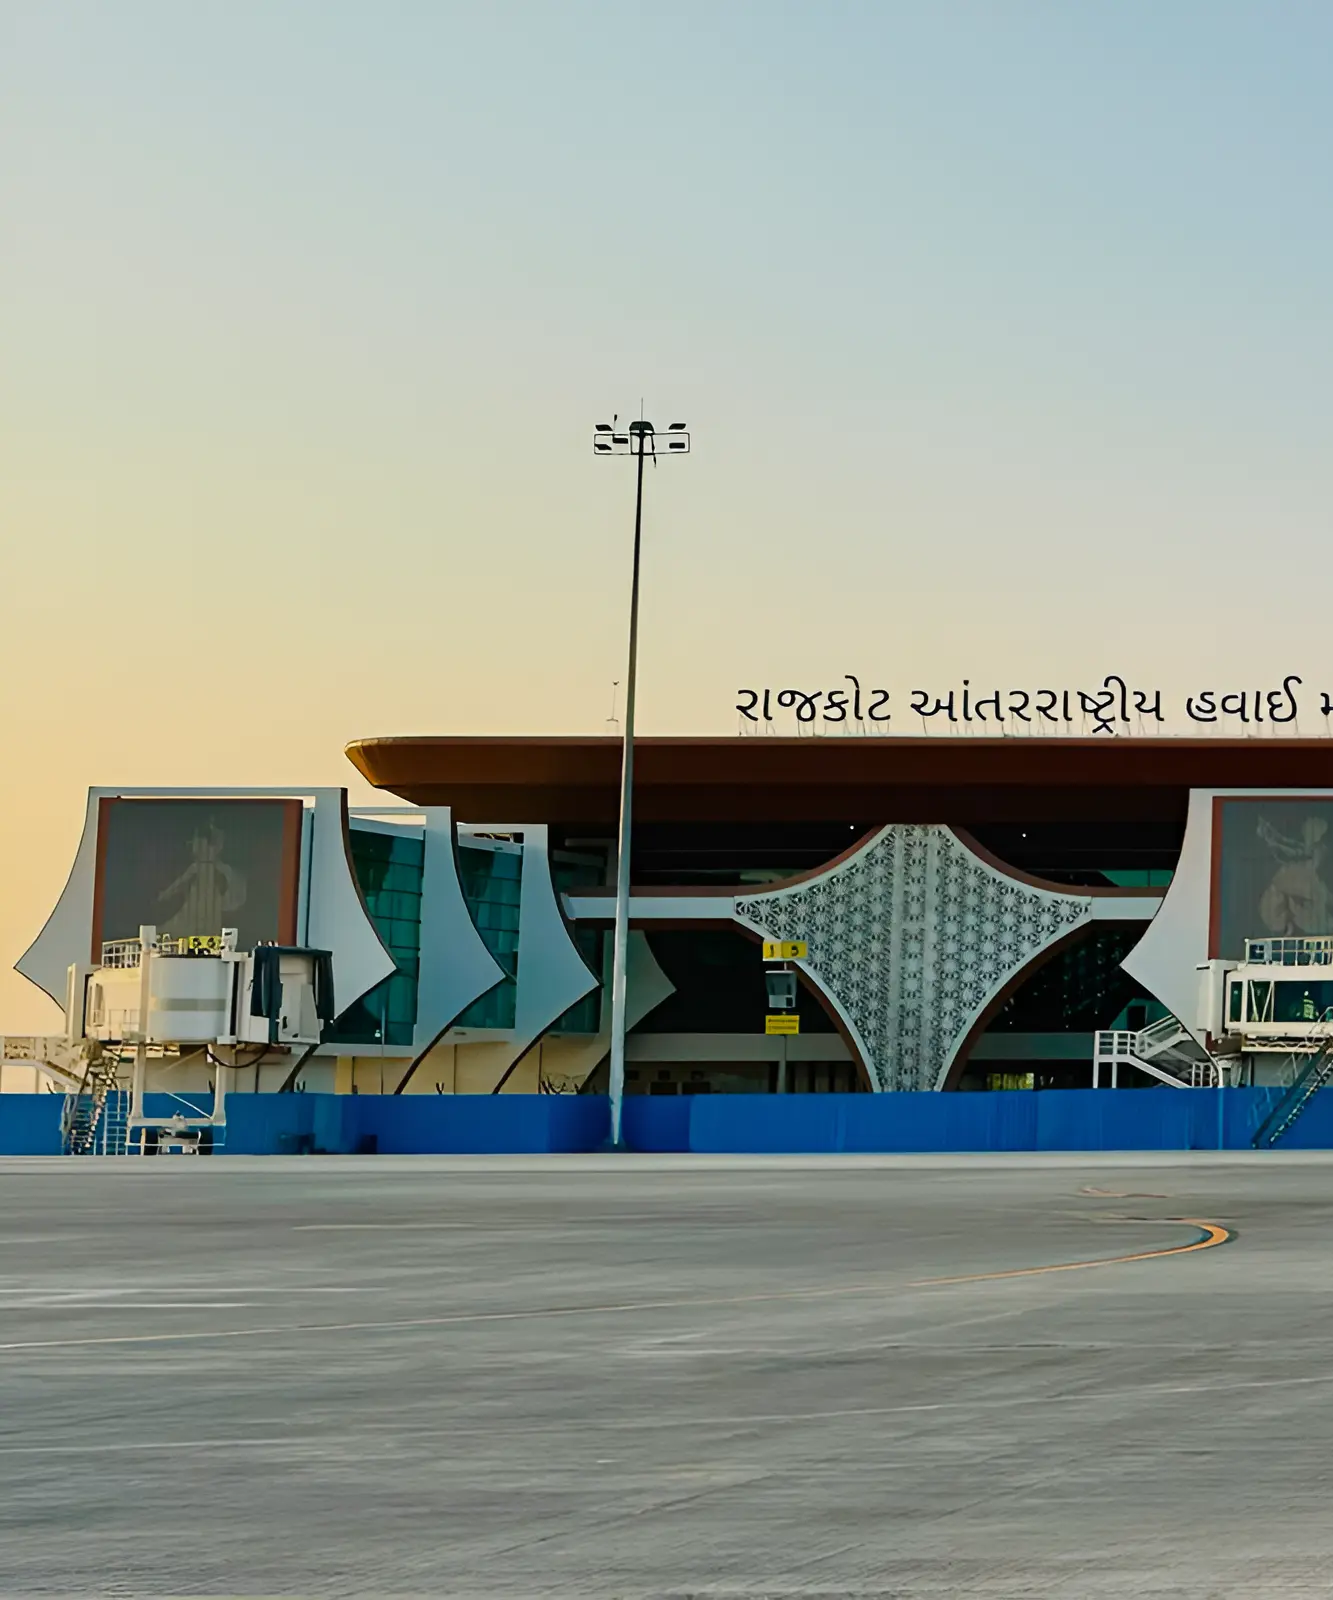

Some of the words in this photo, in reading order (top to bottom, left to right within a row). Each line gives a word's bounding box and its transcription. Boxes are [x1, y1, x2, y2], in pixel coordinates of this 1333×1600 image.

[736, 675, 891, 722] રાજકોટ
[911, 676, 1165, 734] આંતરરાષ્ટ્રીય
[1186, 676, 1303, 722] હવાઈ
